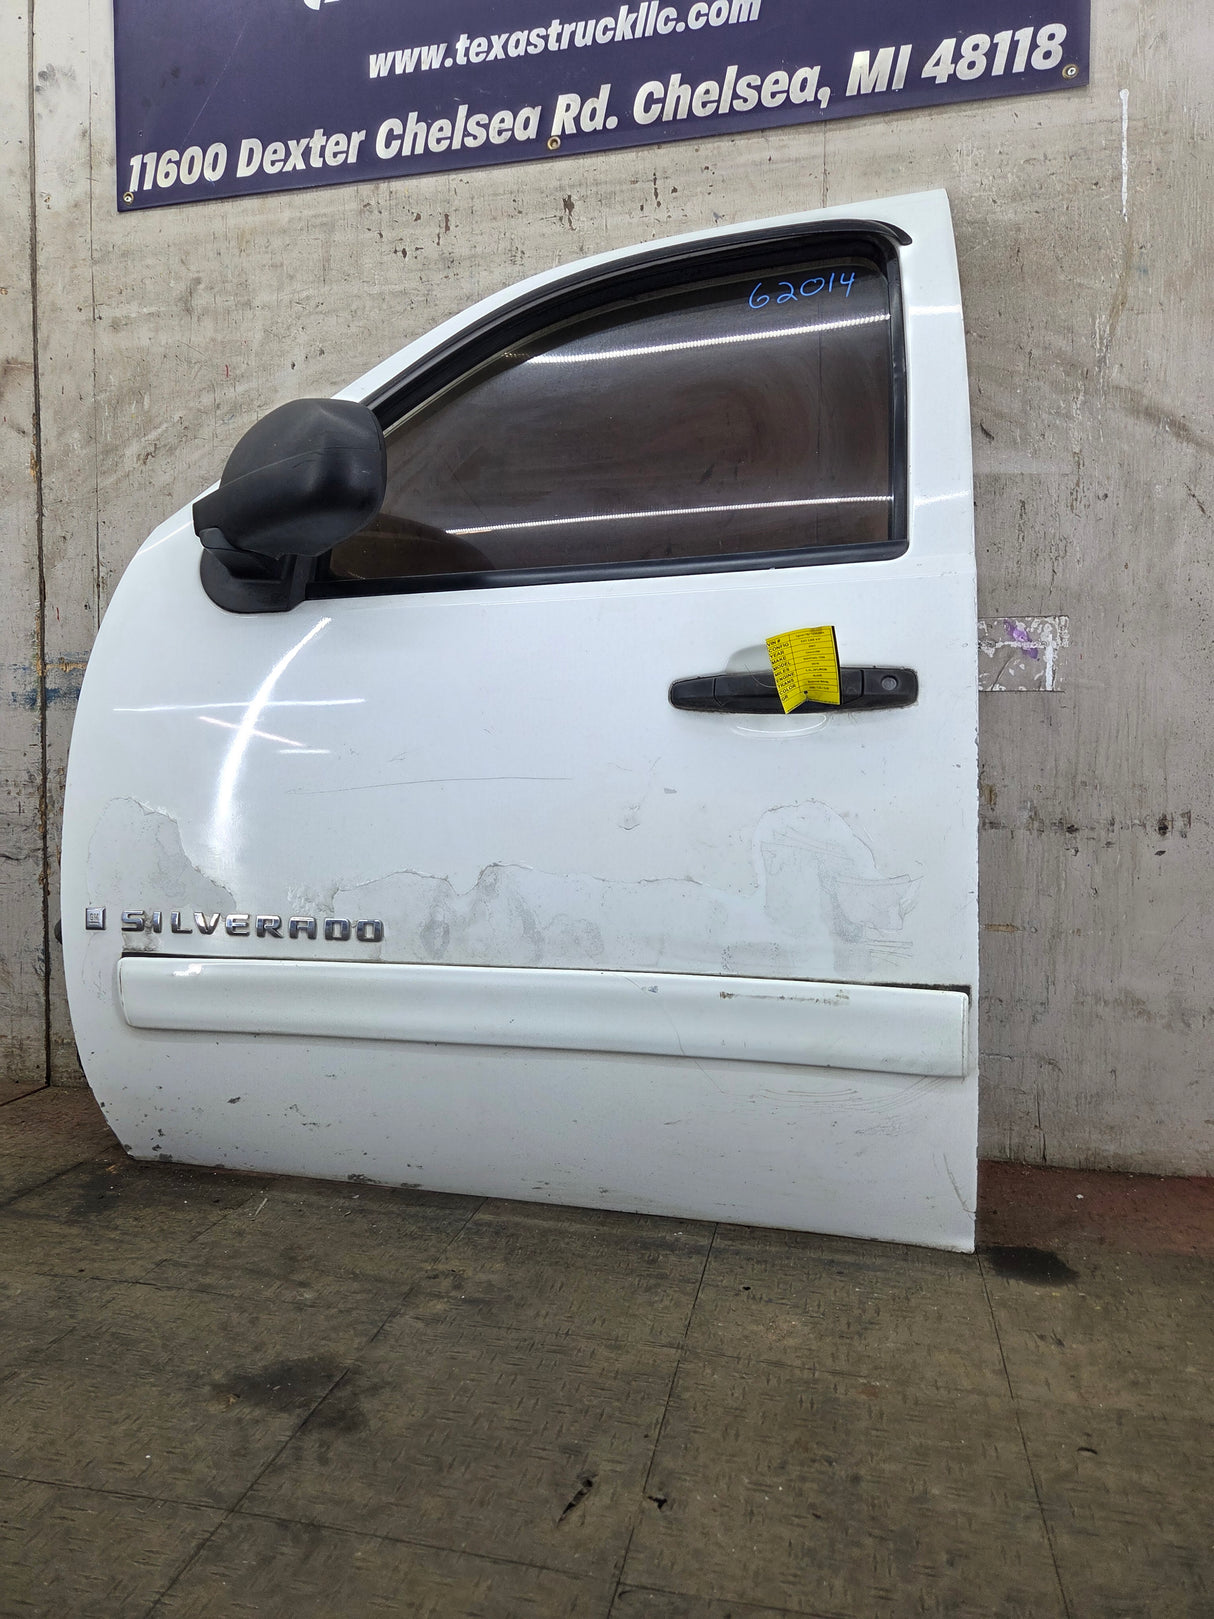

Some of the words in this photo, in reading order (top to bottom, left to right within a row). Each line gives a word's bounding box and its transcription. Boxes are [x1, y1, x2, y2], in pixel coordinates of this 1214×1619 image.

[370, 0, 761, 78] www.texastruckllc.com
[128, 143, 228, 193] 11600
[237, 129, 366, 177] Dexter
[376, 105, 542, 159] Chelsea
[551, 84, 617, 136] Rd.
[634, 65, 830, 125] Chelsea,
[846, 44, 912, 96] MI
[922, 24, 1066, 83] 48118
[749, 273, 854, 308] 62014
[121, 910, 385, 942] SILVERADO
